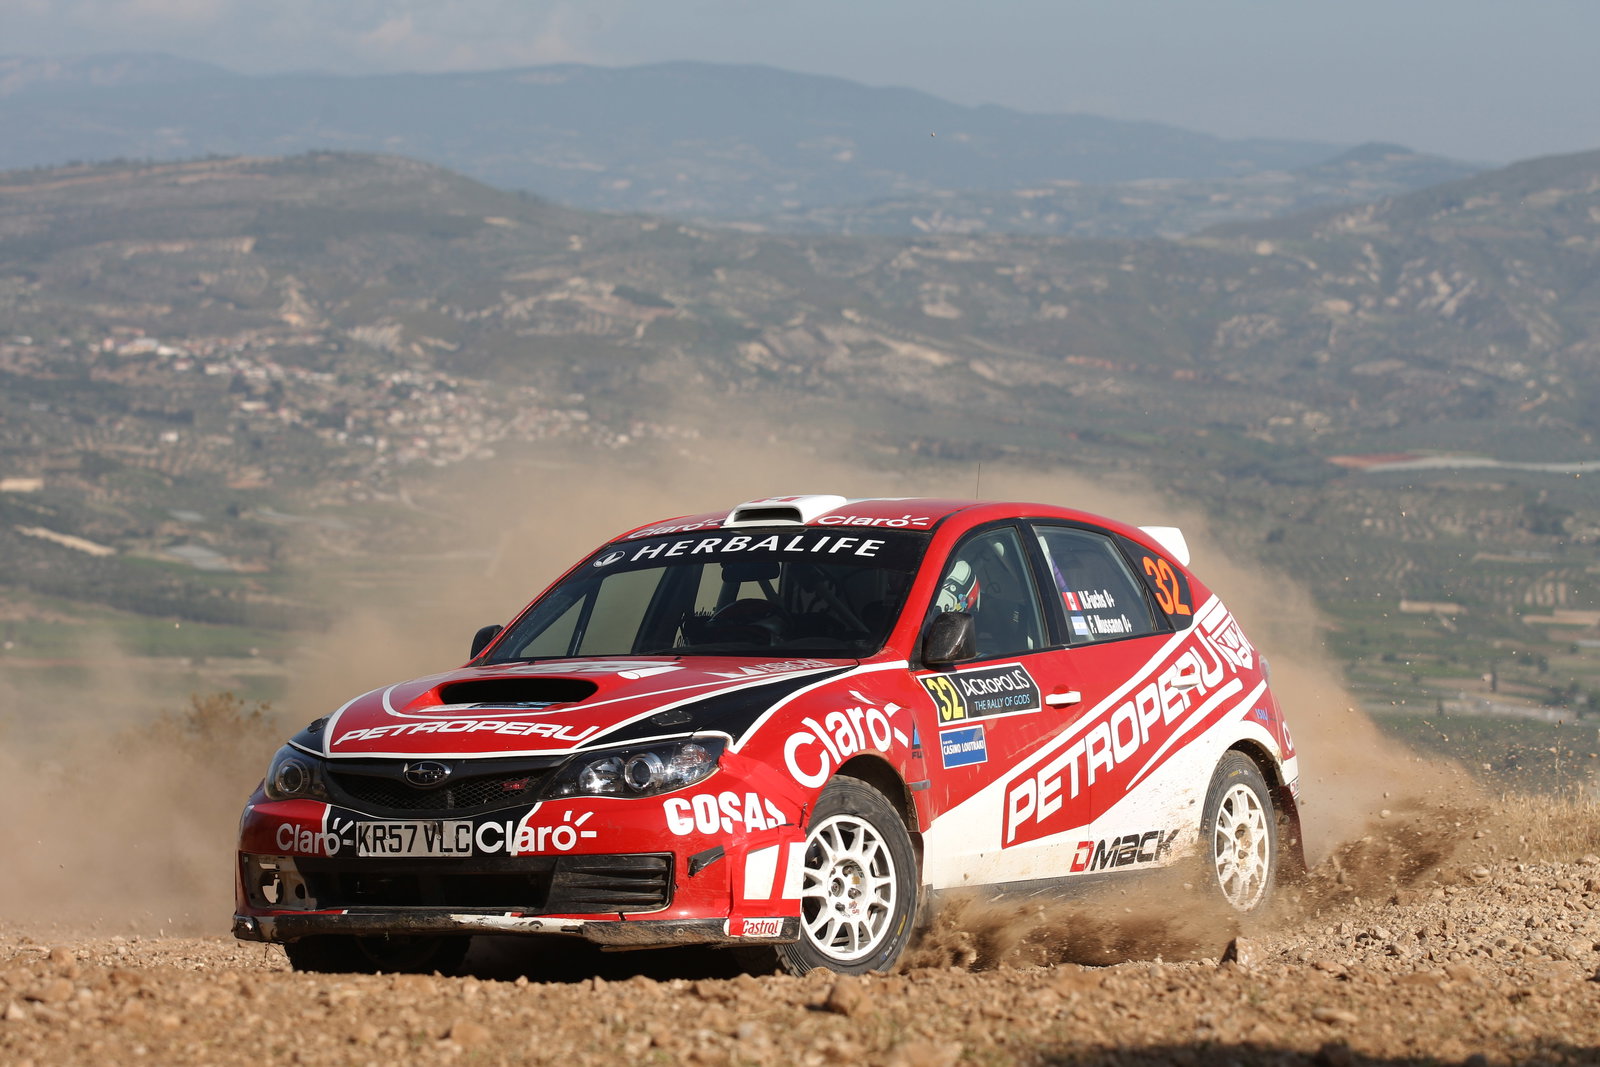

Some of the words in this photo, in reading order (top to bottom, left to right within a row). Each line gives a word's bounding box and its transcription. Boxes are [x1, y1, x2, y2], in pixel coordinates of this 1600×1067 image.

[627, 523, 704, 539] Claro
[817, 515, 909, 527] Claro
[630, 535, 885, 562] HERBALIFE
[1143, 556, 1191, 616] 32
[960, 669, 1030, 697] ACROPOLIS
[926, 676, 964, 721] 32
[975, 701, 986, 711] THE
[987, 698, 1004, 710] RALLY
[1005, 697, 1013, 707] OF
[1014, 694, 1031, 705] GODS
[333, 720, 600, 745] PETROPERU
[1007, 627, 1224, 844] PETROPERU
[784, 706, 891, 789] Claro
[943, 744, 962, 755] CASINO
[276, 822, 340, 856] Claro
[359, 824, 418, 853] KR57
[424, 823, 471, 853] VLC
[476, 820, 577, 853] Claro
[743, 920, 778, 934] Castrol
